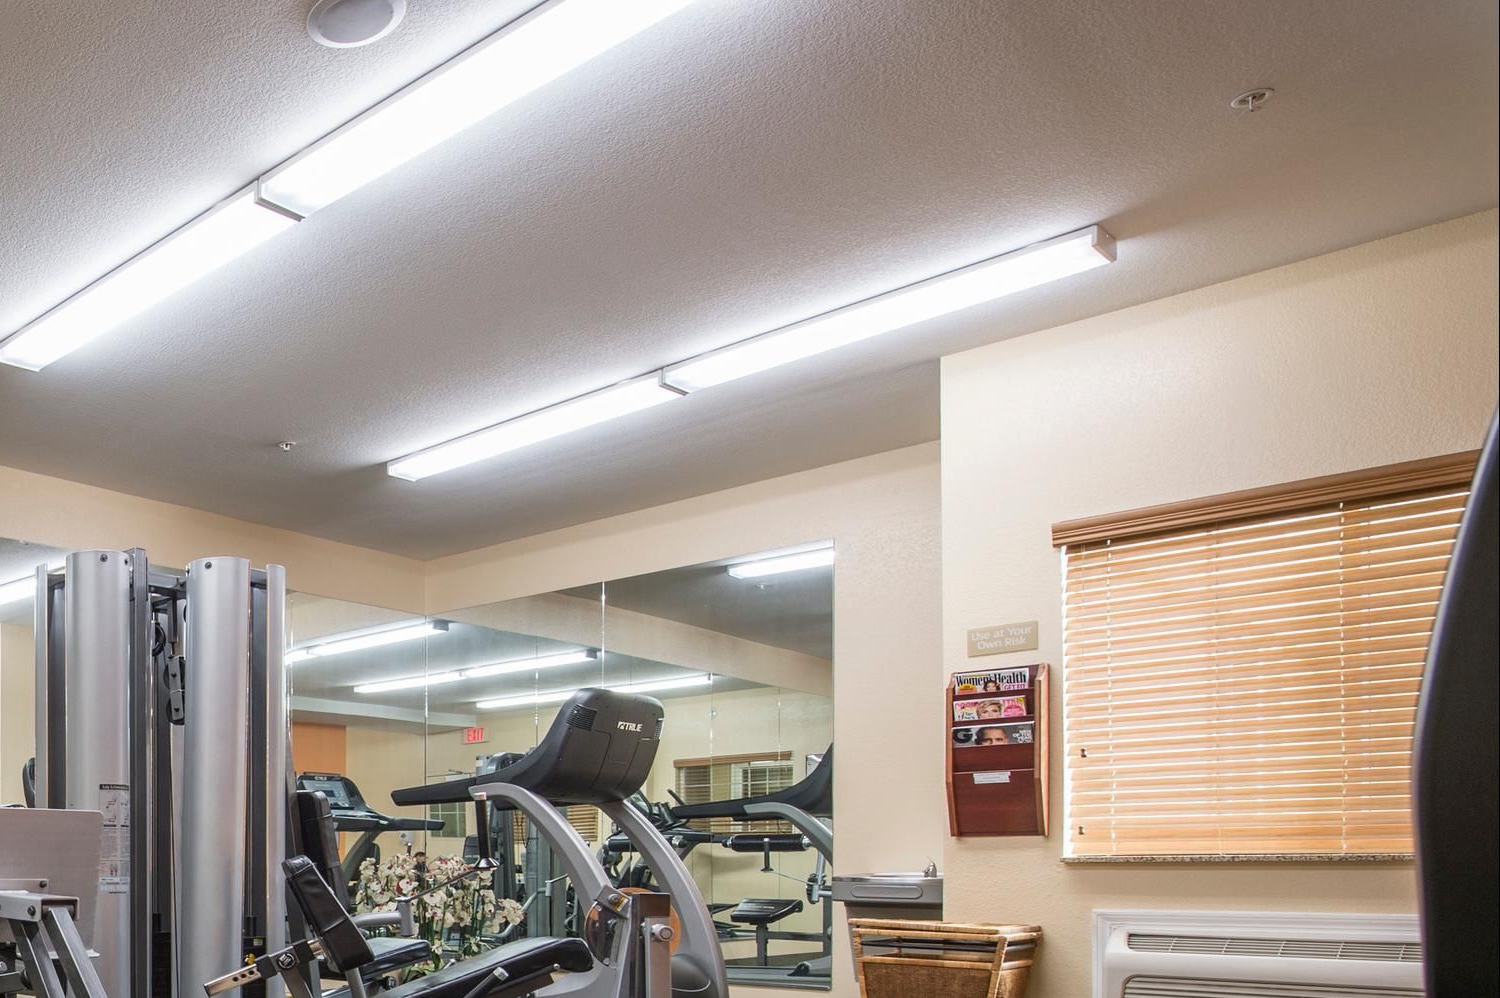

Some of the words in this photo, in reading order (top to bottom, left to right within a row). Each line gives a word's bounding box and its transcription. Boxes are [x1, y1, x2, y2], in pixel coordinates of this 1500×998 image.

[971, 631, 990, 641] Use
[994, 629, 1005, 638] at
[1006, 625, 1033, 637] Your
[977, 640, 1002, 650] Own
[1005, 635, 1028, 646] Risk
[995, 671, 1027, 684] Health
